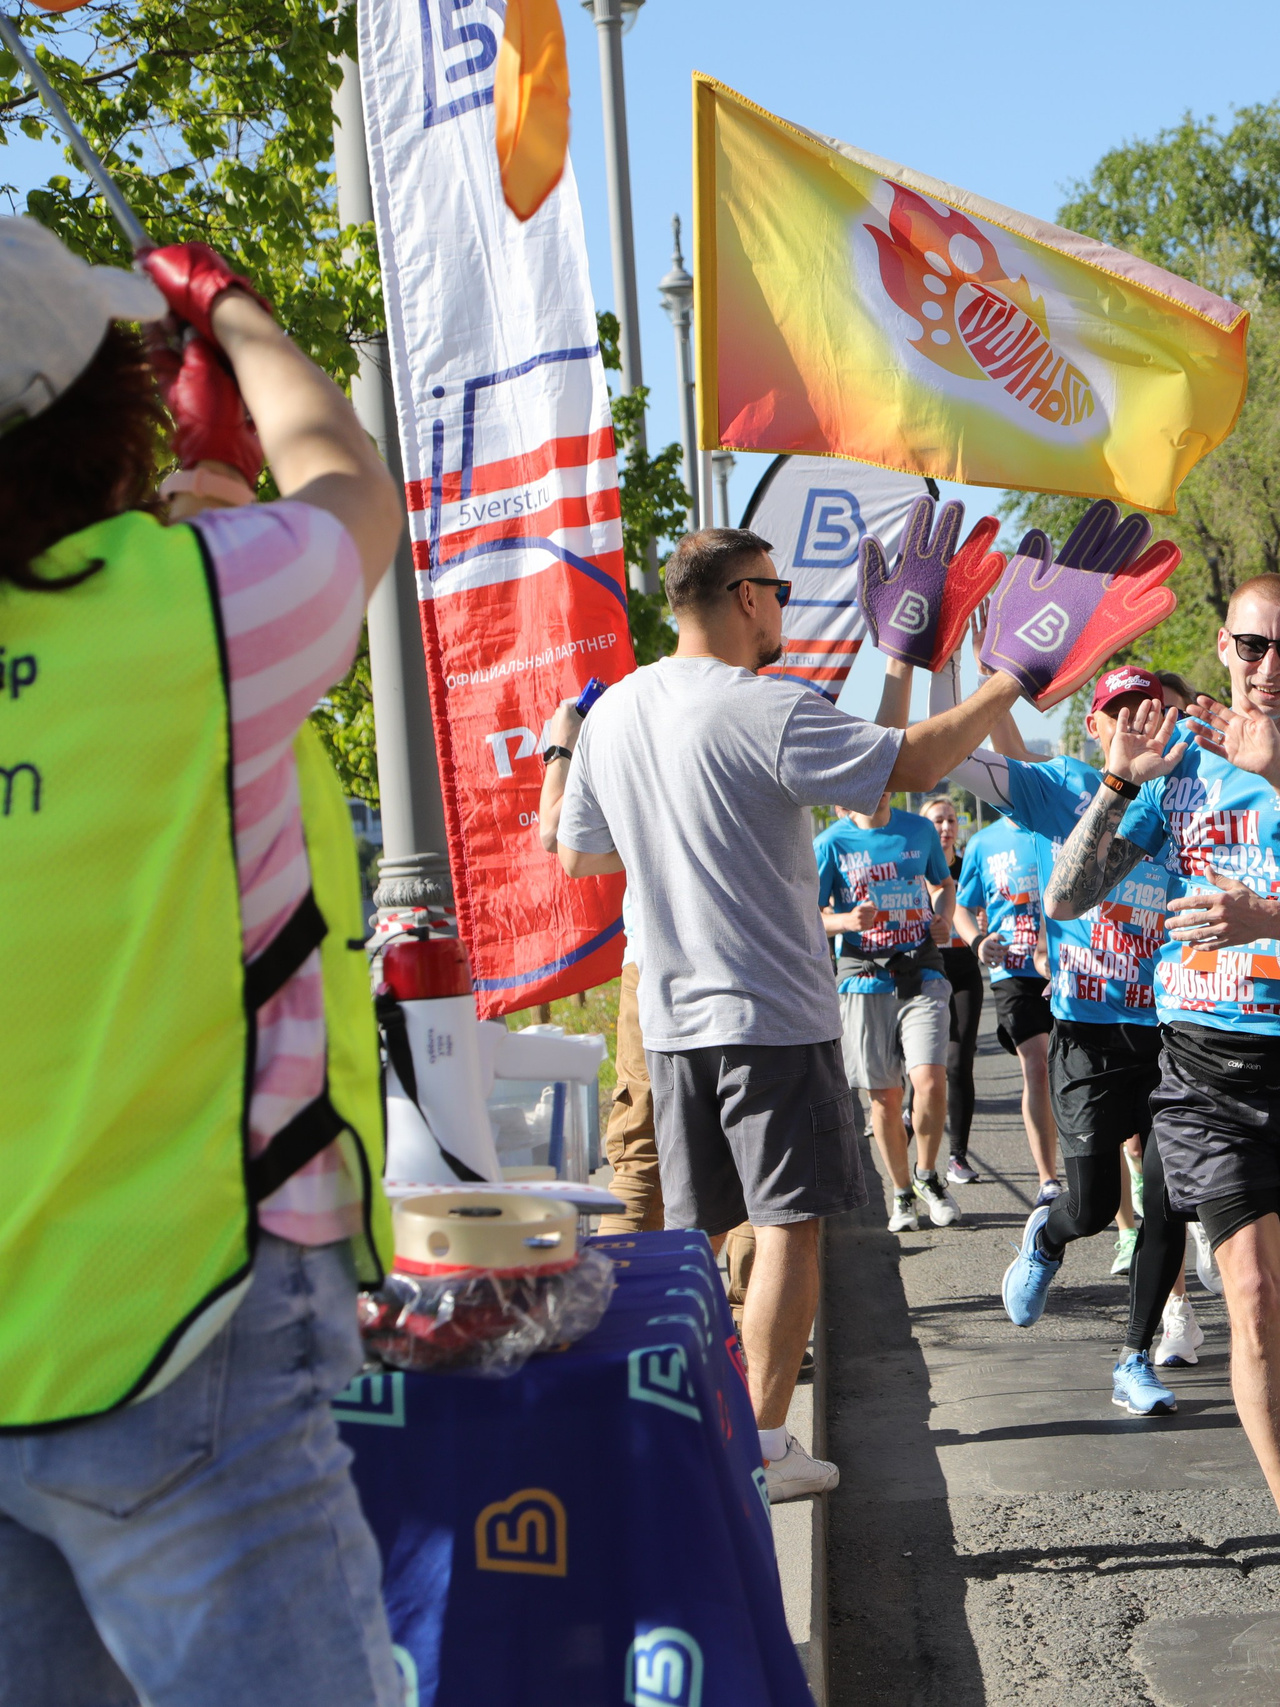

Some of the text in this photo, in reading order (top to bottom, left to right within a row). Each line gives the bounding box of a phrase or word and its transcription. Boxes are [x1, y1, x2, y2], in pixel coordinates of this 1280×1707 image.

[459, 486, 550, 526] 5verst.ru
[446, 632, 617, 690] ОФИЦИАЛЬНЫЙ ПАРТНЕР
[1163, 776, 1223, 812] 2024
[518, 810, 540, 827] ОА
[1169, 809, 1260, 847] #МЕЧТА
[839, 850, 872, 872] 2024
[986, 849, 1018, 875] 2024
[1018, 874, 1038, 891] 233
[1121, 880, 1167, 911] 2192
[881, 893, 914, 909] 25741
[1028, 890, 1041, 903] 5K
[888, 909, 907, 921] 5KM
[1130, 906, 1160, 930] 5KM
[1059, 943, 1140, 983] #ЛЮБОВЬ
[1216, 950, 1253, 978] 5KM
